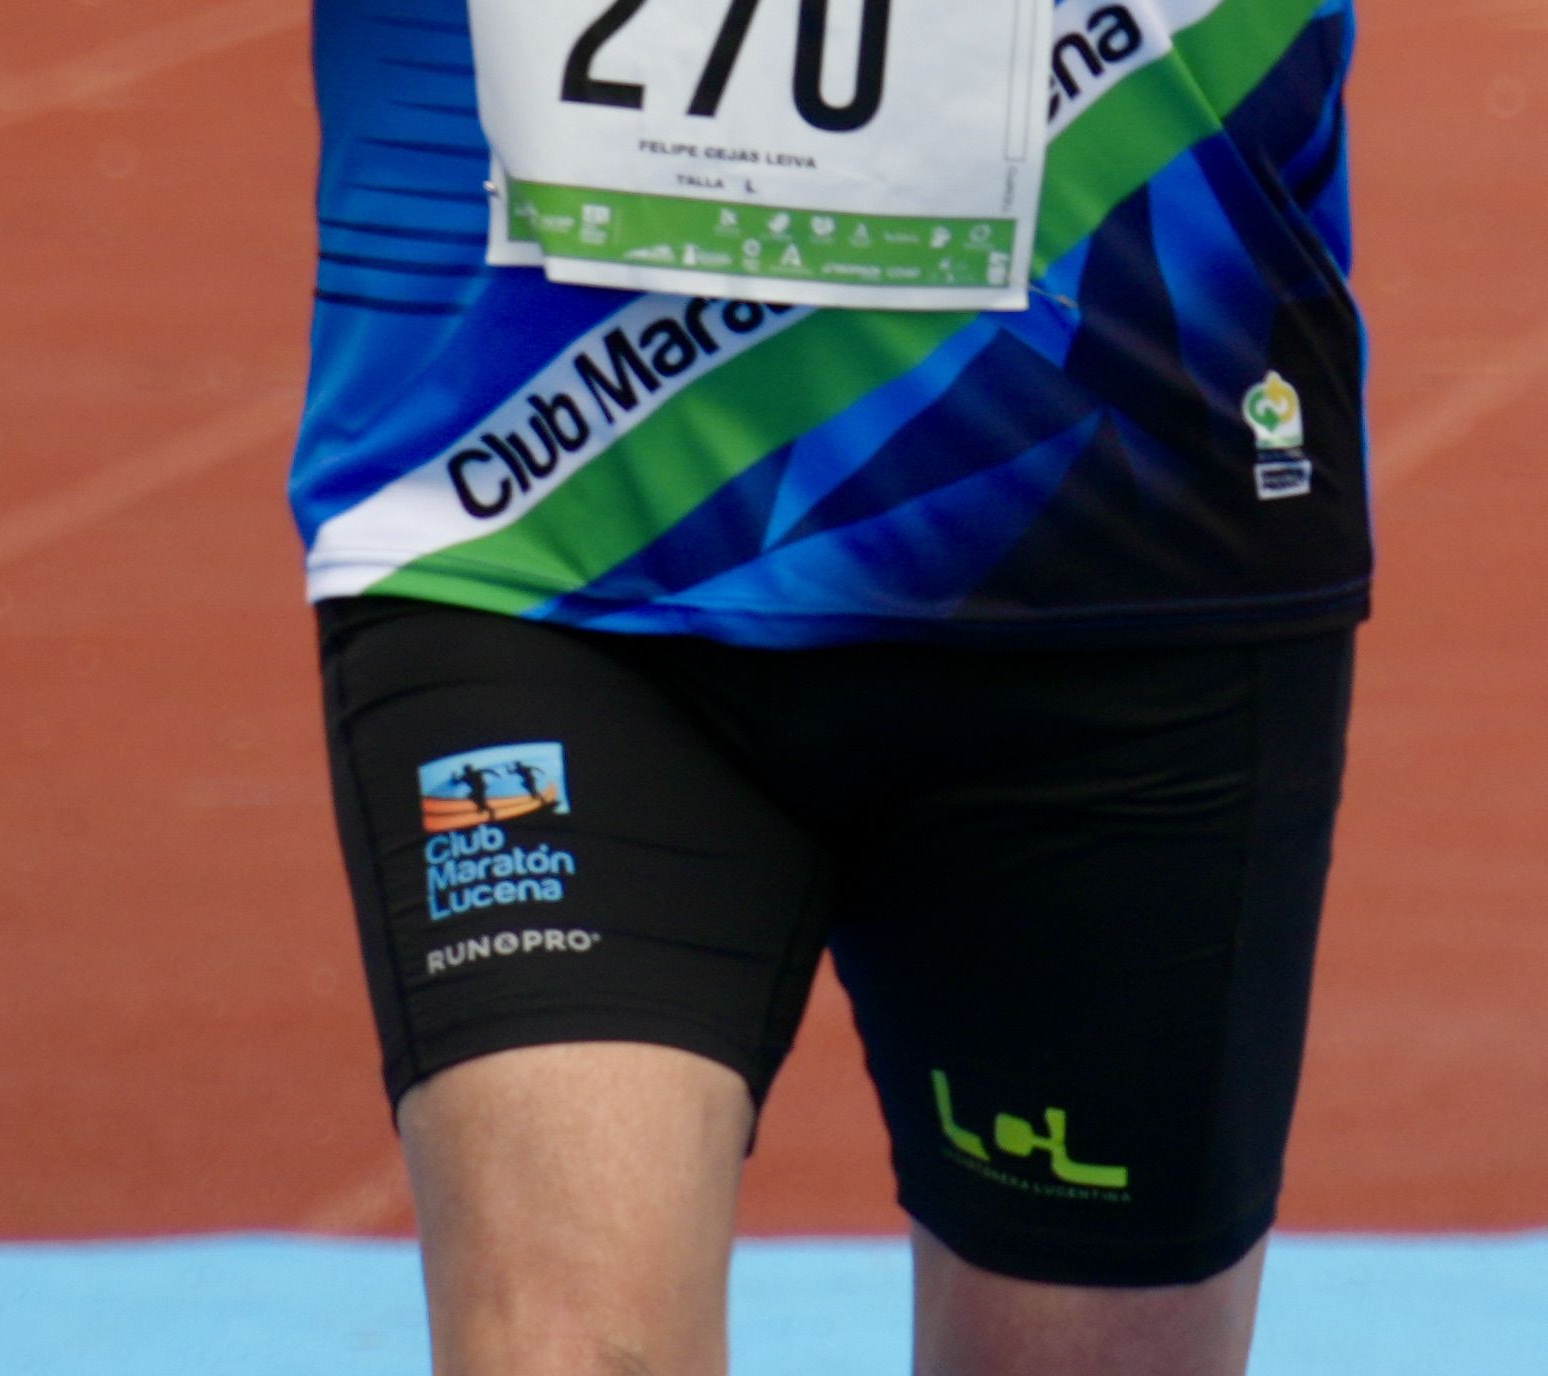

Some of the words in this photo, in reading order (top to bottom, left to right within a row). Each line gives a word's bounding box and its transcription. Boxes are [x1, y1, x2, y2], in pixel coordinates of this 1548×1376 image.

[639, 140, 698, 157] FELIPE
[766, 152, 817, 168] LEIVA
[676, 174, 725, 189] TALLA
[447, 394, 590, 519] Club
[573, 298, 795, 426] Mara
[425, 823, 506, 866] Club
[427, 843, 576, 891] Maratón
[429, 877, 564, 921] Lucena
